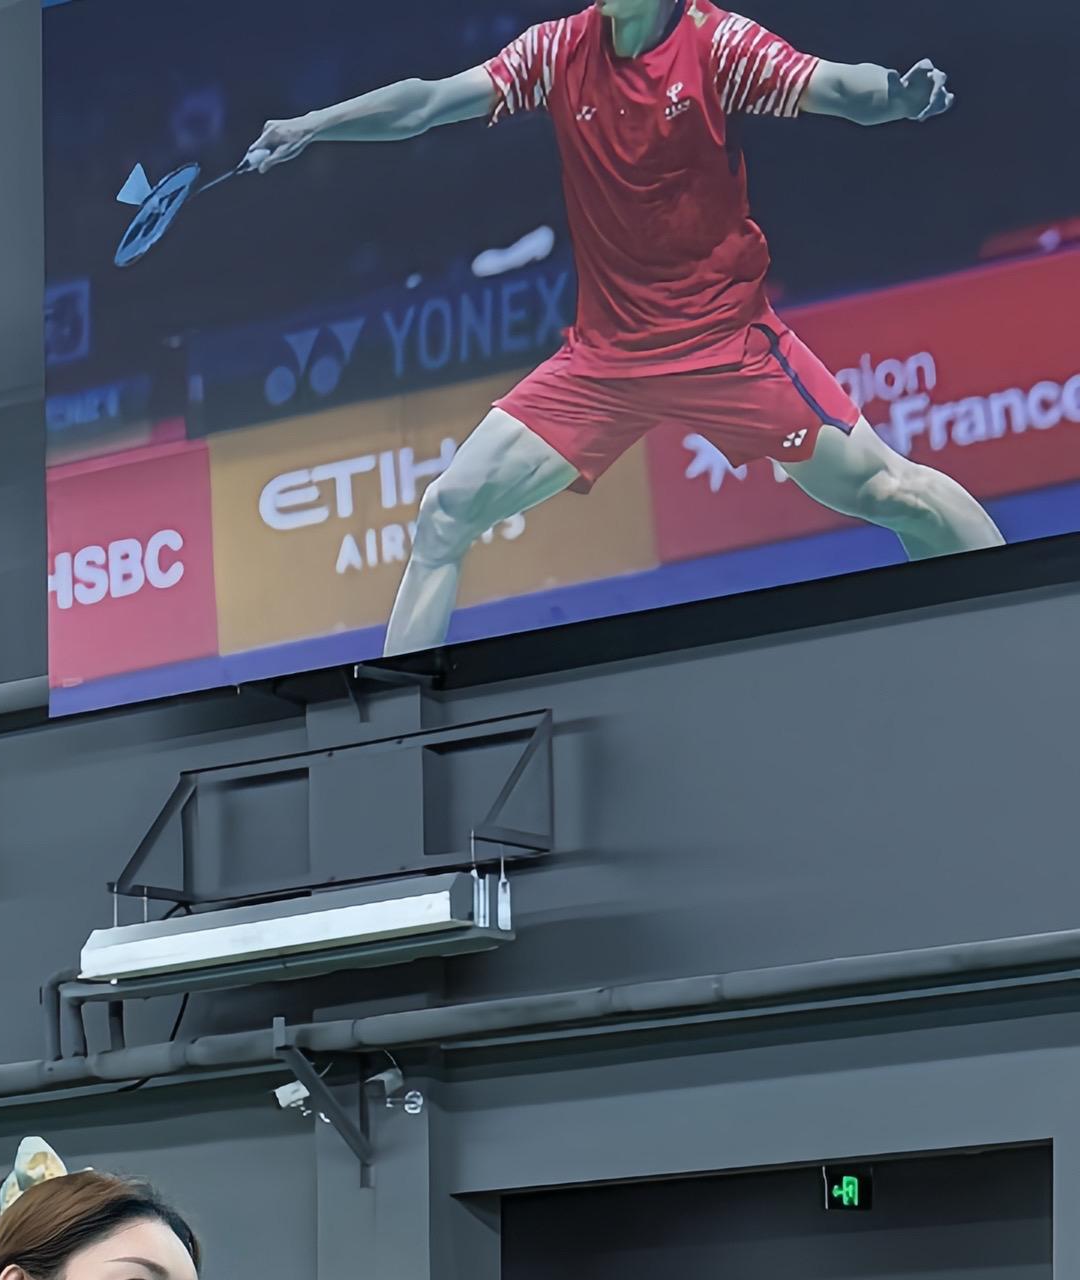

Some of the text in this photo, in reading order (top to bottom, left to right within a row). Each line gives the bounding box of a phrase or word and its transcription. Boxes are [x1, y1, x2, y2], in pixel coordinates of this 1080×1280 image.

[386, 273, 567, 375] YONEX
[834, 350, 937, 408] gion
[259, 439, 458, 530] ETIH
